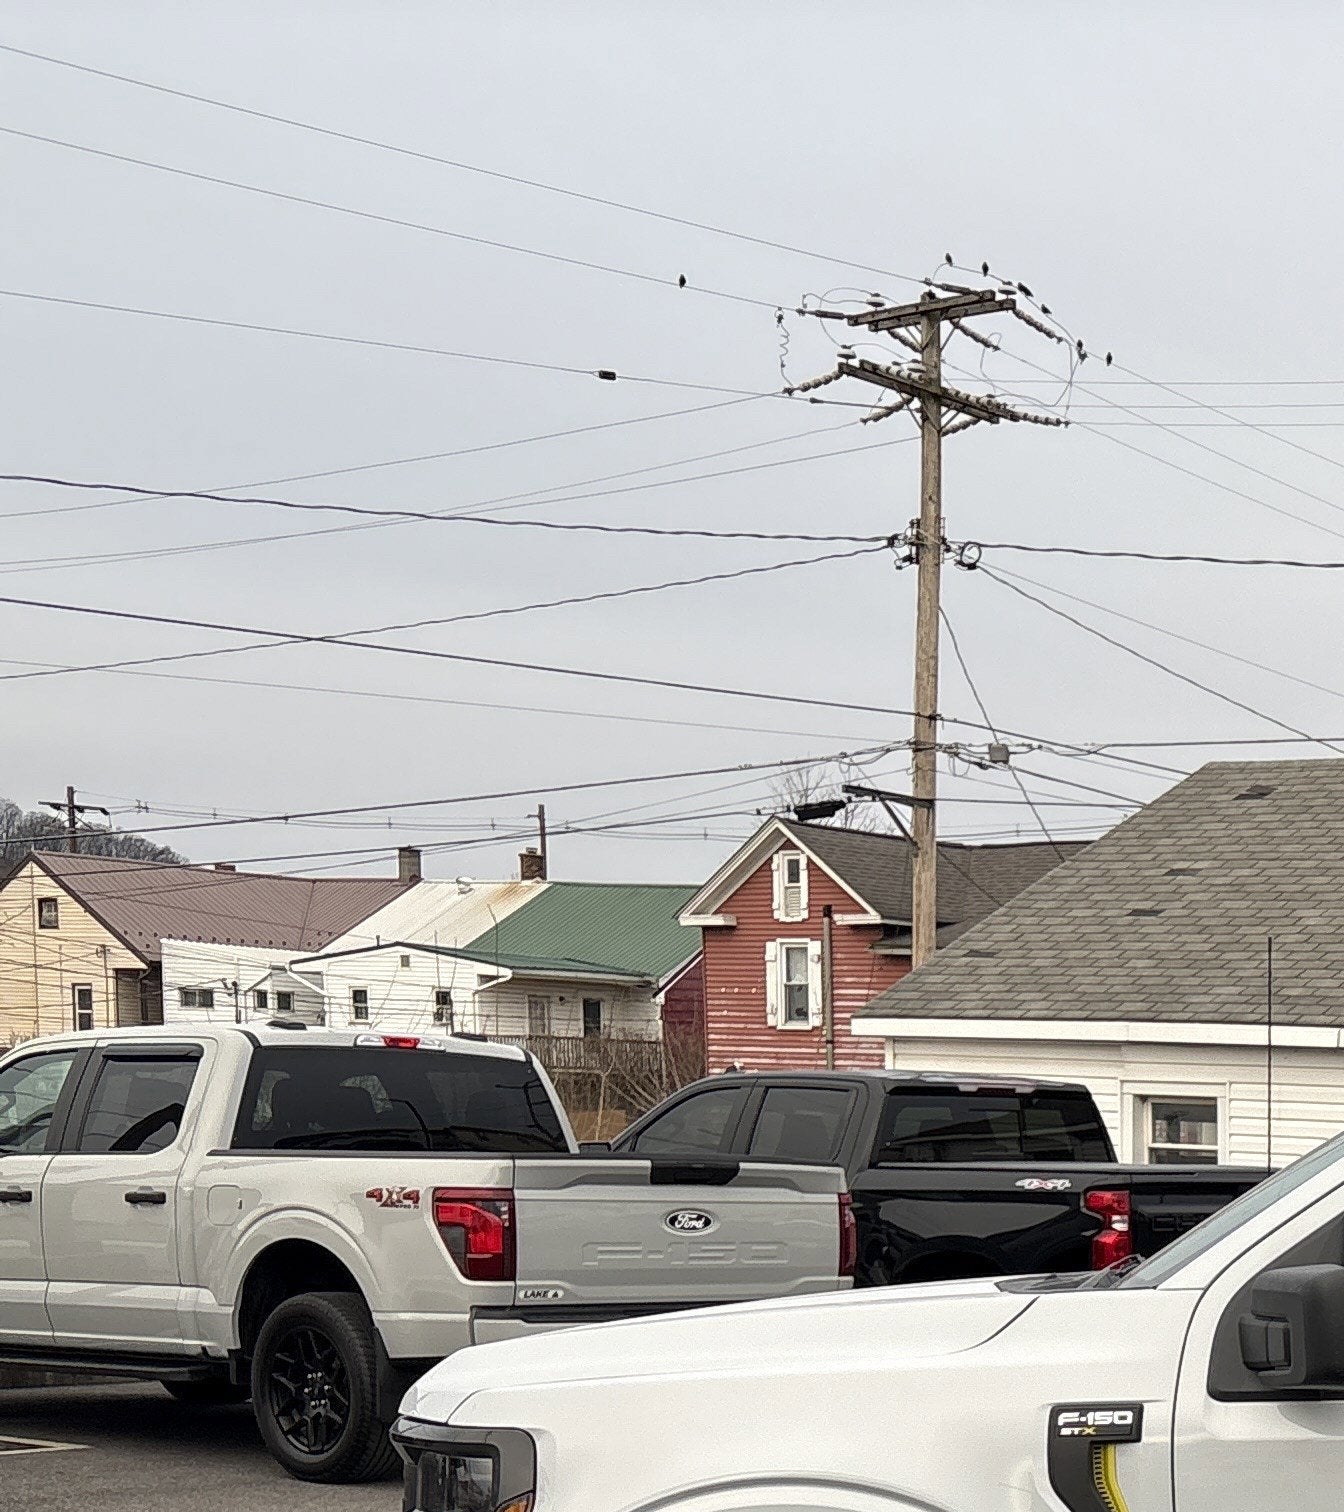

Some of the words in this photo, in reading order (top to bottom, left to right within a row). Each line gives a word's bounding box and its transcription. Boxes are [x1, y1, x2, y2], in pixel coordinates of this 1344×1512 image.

[674, 1213, 705, 1229] Ford
[581, 1241, 789, 1266] F-150
[1057, 1410, 1134, 1426] F-150
